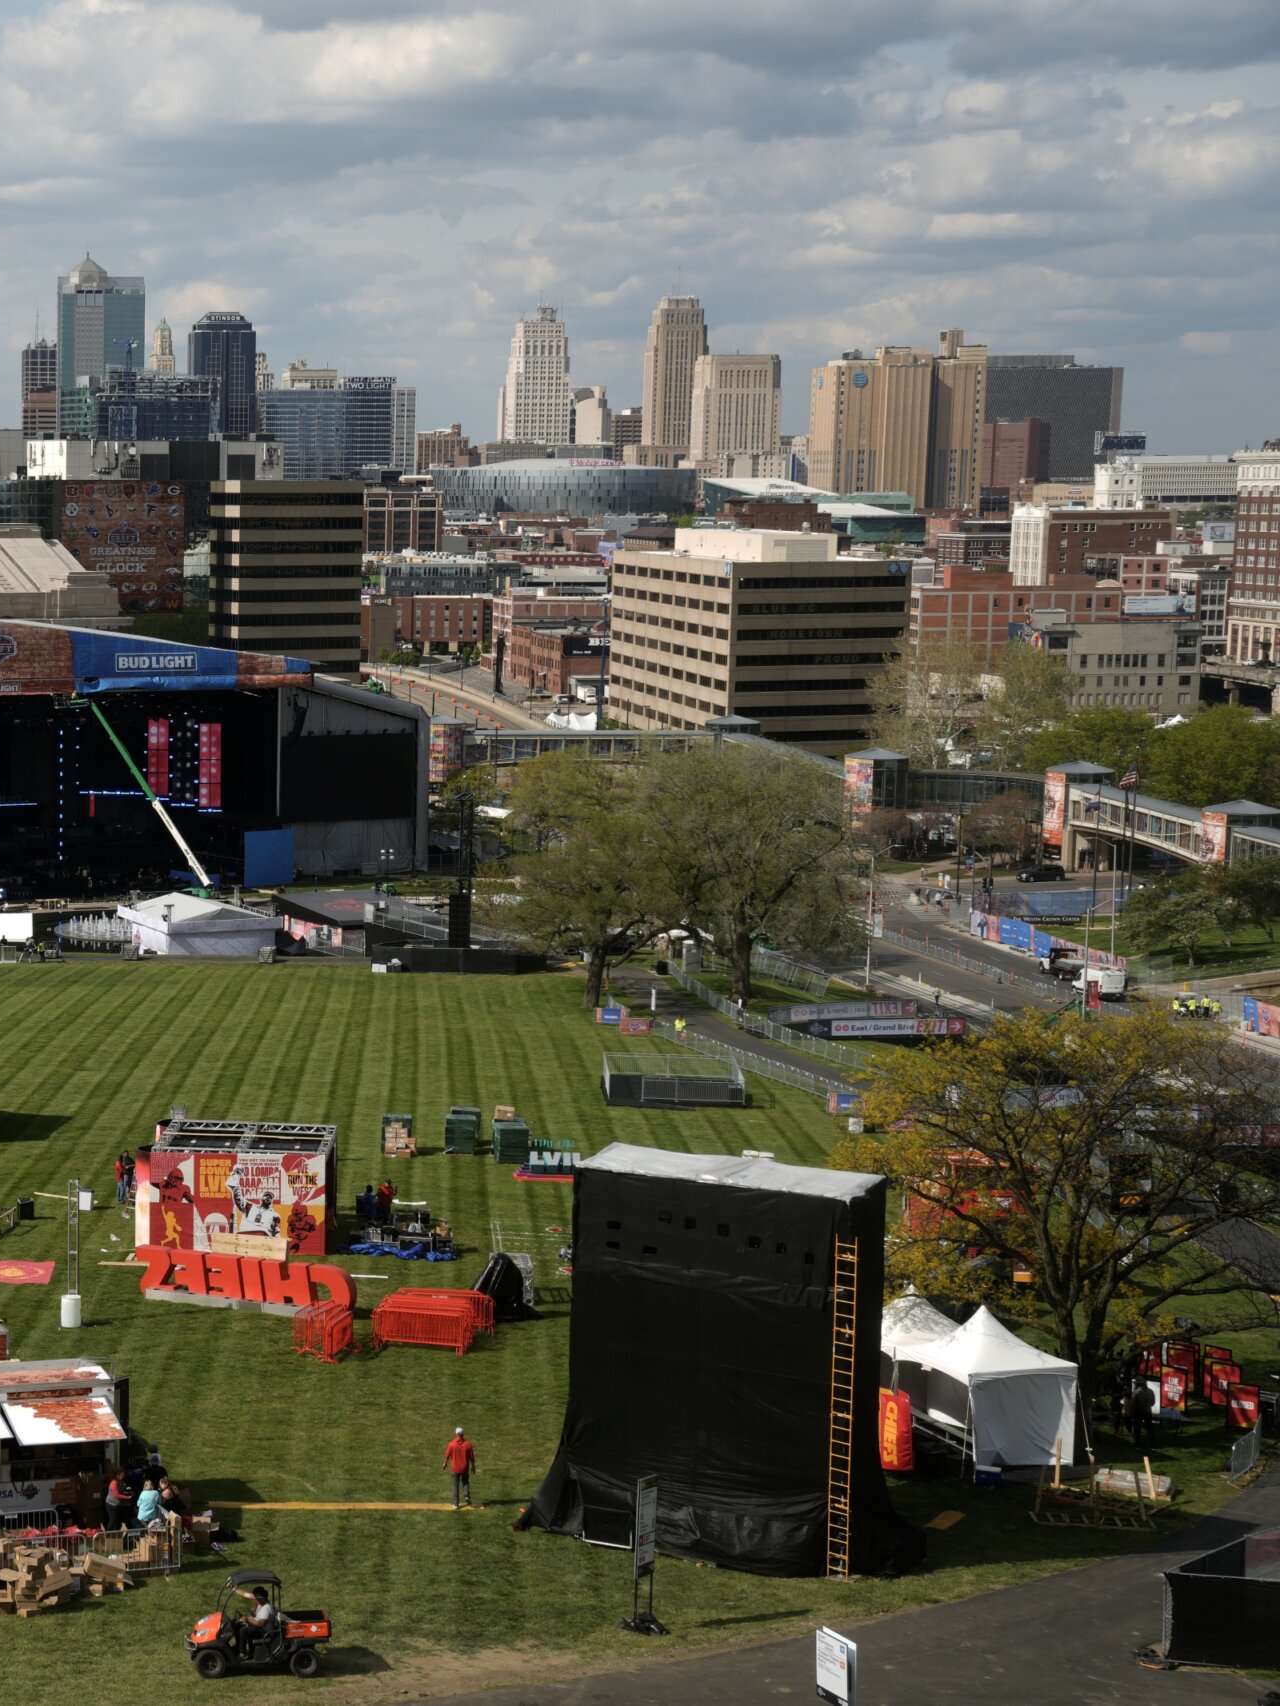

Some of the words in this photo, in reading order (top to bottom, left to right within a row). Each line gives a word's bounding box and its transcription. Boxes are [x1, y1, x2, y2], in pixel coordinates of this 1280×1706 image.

[345, 382, 365, 390] TWO
[366, 382, 391, 390] LIGHT
[89, 547, 157, 556] GREATNESS
[96, 563, 147, 573] CLOCK
[752, 603, 787, 614] BLUE
[798, 603, 817, 613] KC
[769, 628, 843, 639] HOMETOWN
[118, 656, 150, 669] BUD
[151, 655, 194, 668] LIGHT
[814, 653, 860, 664] PROUD
[873, 1024, 896, 1032] Grand
[897, 1023, 915, 1031] Blvd
[915, 1019, 945, 1033] EXIT
[199, 1158, 232, 1167] SUPER
[529, 1151, 582, 1167] LVII
[199, 1166, 232, 1175] BOWL
[288, 1174, 303, 1185] RUN
[305, 1174, 318, 1185] THE
[882, 1400, 898, 1466] CHIEFS
